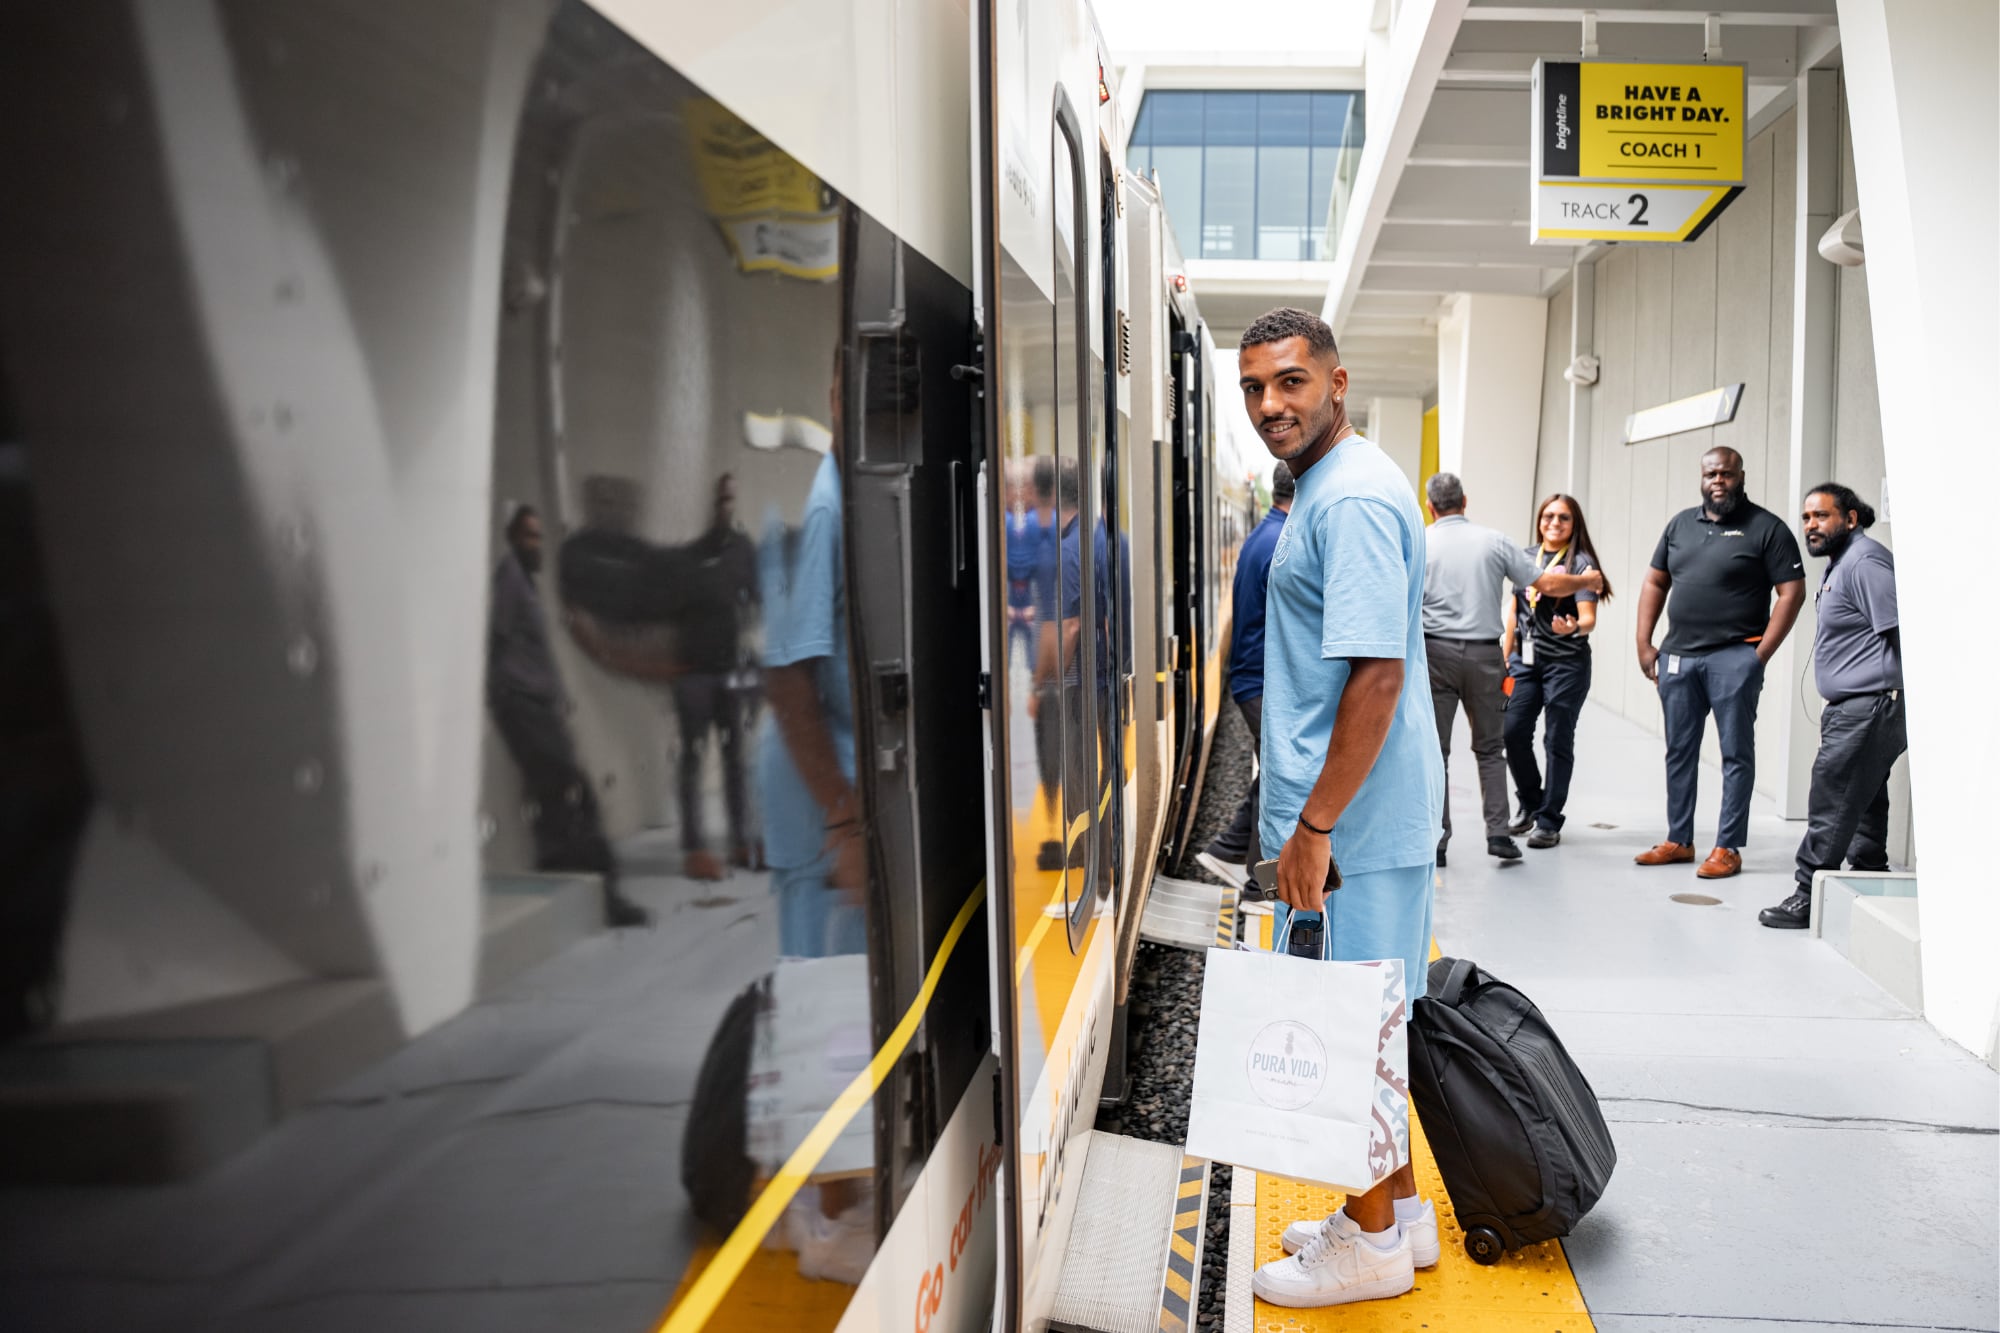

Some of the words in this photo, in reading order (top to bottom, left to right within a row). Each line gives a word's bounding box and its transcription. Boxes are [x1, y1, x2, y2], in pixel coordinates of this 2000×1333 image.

[1624, 85, 1681, 101] HAVE
[1686, 86, 1702, 102] A
[1555, 93, 1571, 150] brightline
[1596, 105, 1676, 121] BRIGHT
[1682, 107, 1730, 123] DAY.
[1620, 142, 1687, 158] COACH
[1694, 143, 1702, 158] 1
[1560, 201, 1621, 220] TRACK
[1627, 193, 1649, 226] 2
[1252, 1052, 1286, 1075] PURA
[1290, 1057, 1318, 1080] VIDA
[915, 1262, 944, 1333] Go
[950, 1183, 976, 1273] car
